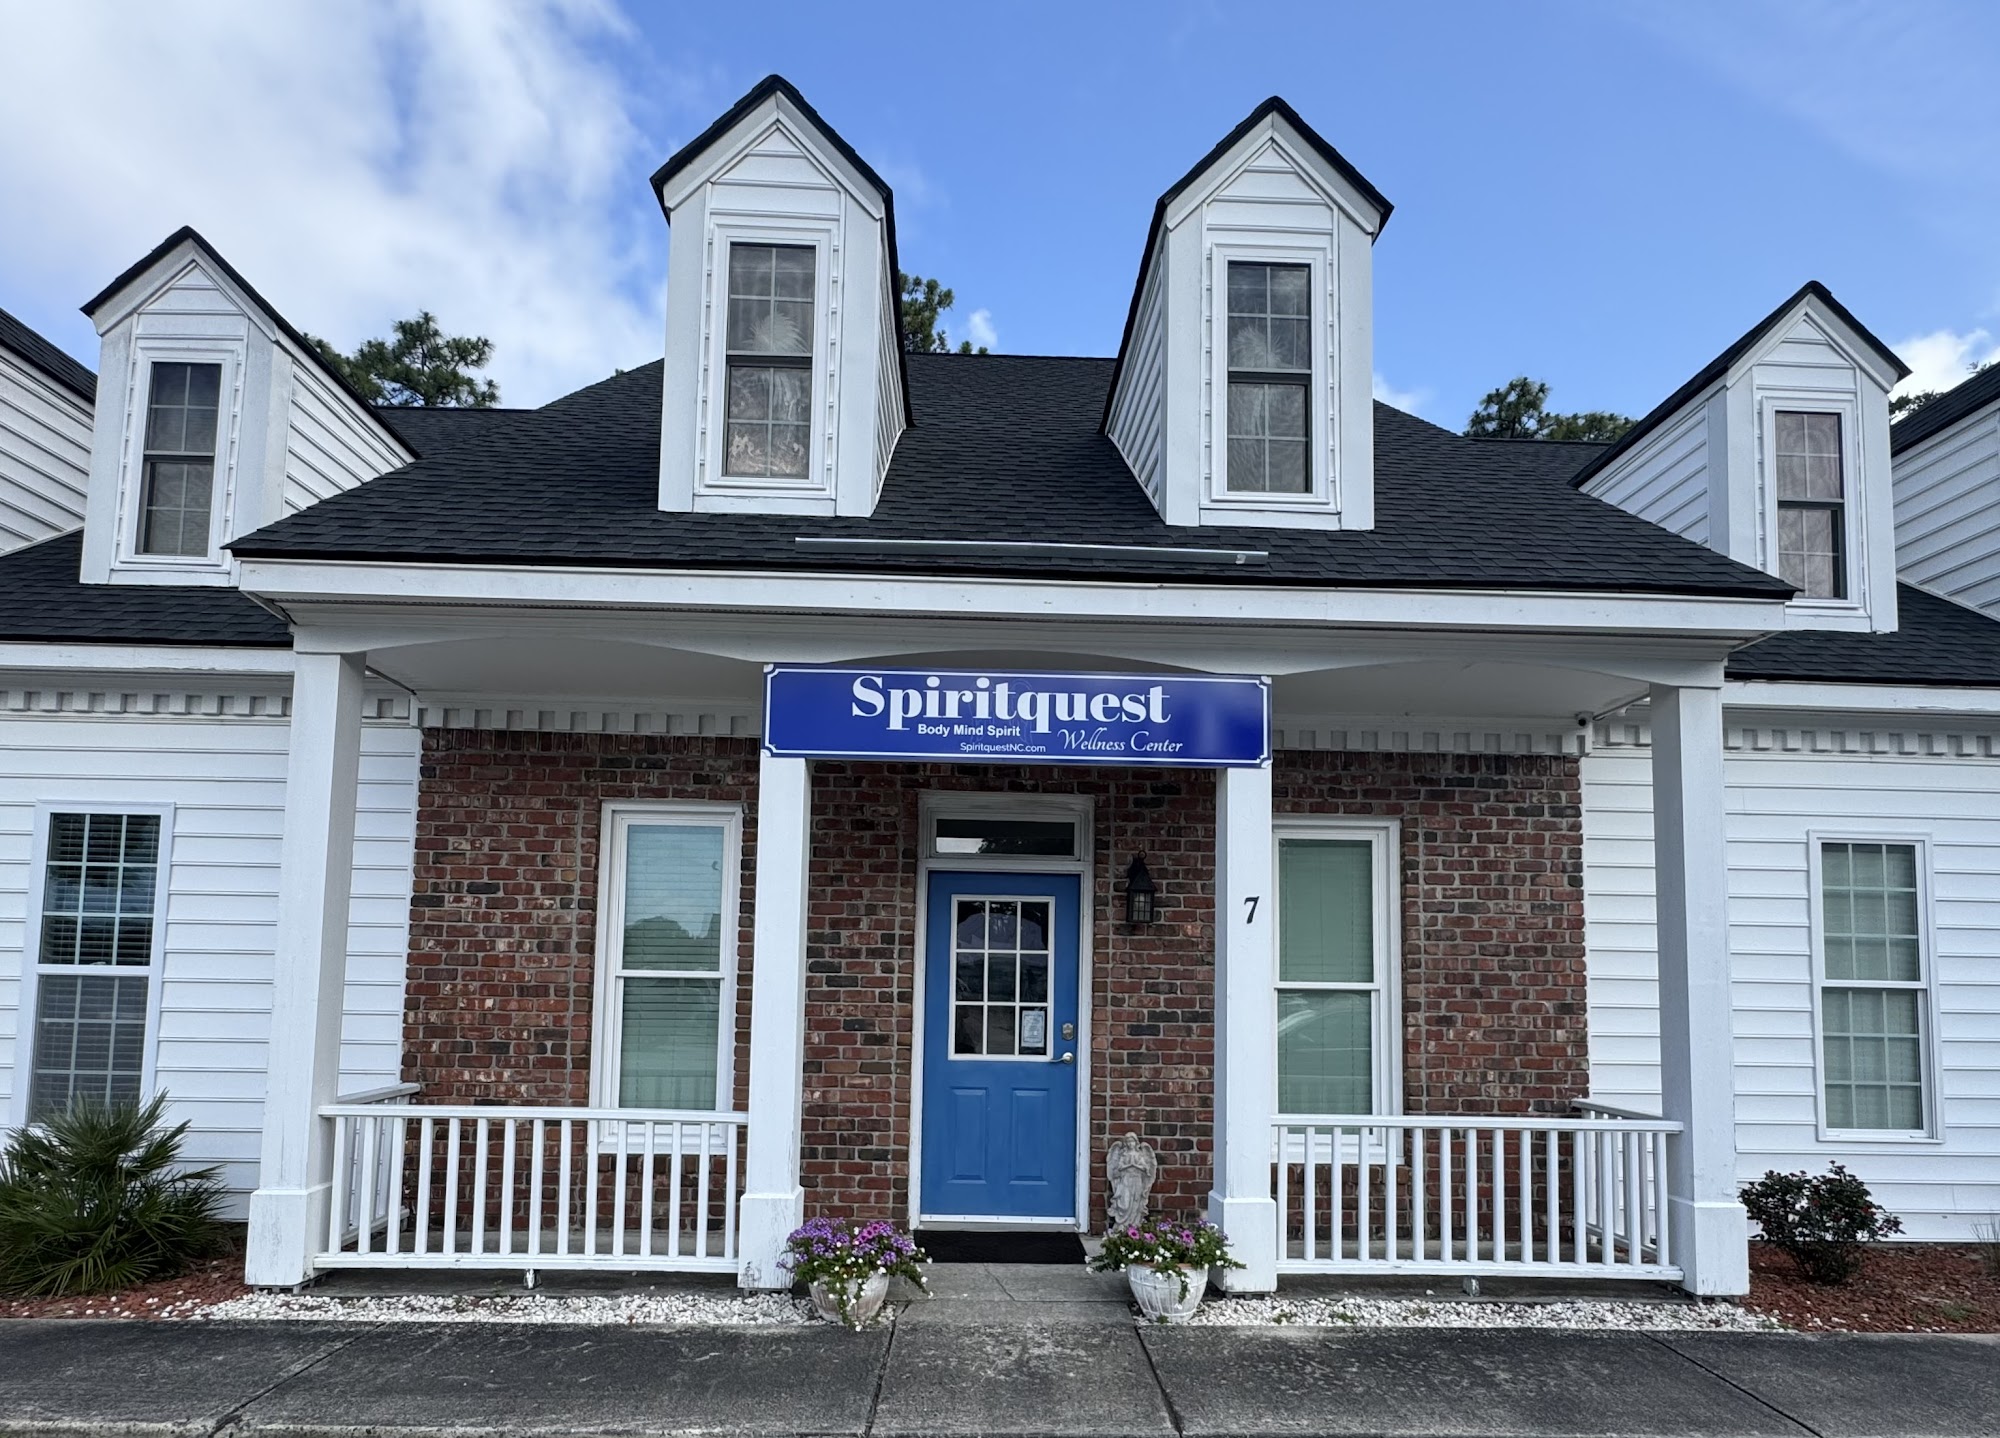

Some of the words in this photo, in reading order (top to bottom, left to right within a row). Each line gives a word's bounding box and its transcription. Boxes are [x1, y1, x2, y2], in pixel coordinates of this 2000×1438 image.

[852, 675, 1171, 733] Spiritquest
[917, 723, 950, 737] Body
[953, 724, 984, 736] Mind
[987, 725, 1021, 738] Spirit
[1057, 727, 1126, 751] Wellness
[1130, 731, 1184, 752] Center
[960, 742, 1046, 753] SpiritquestNC.com
[1243, 895, 1260, 925] 7
